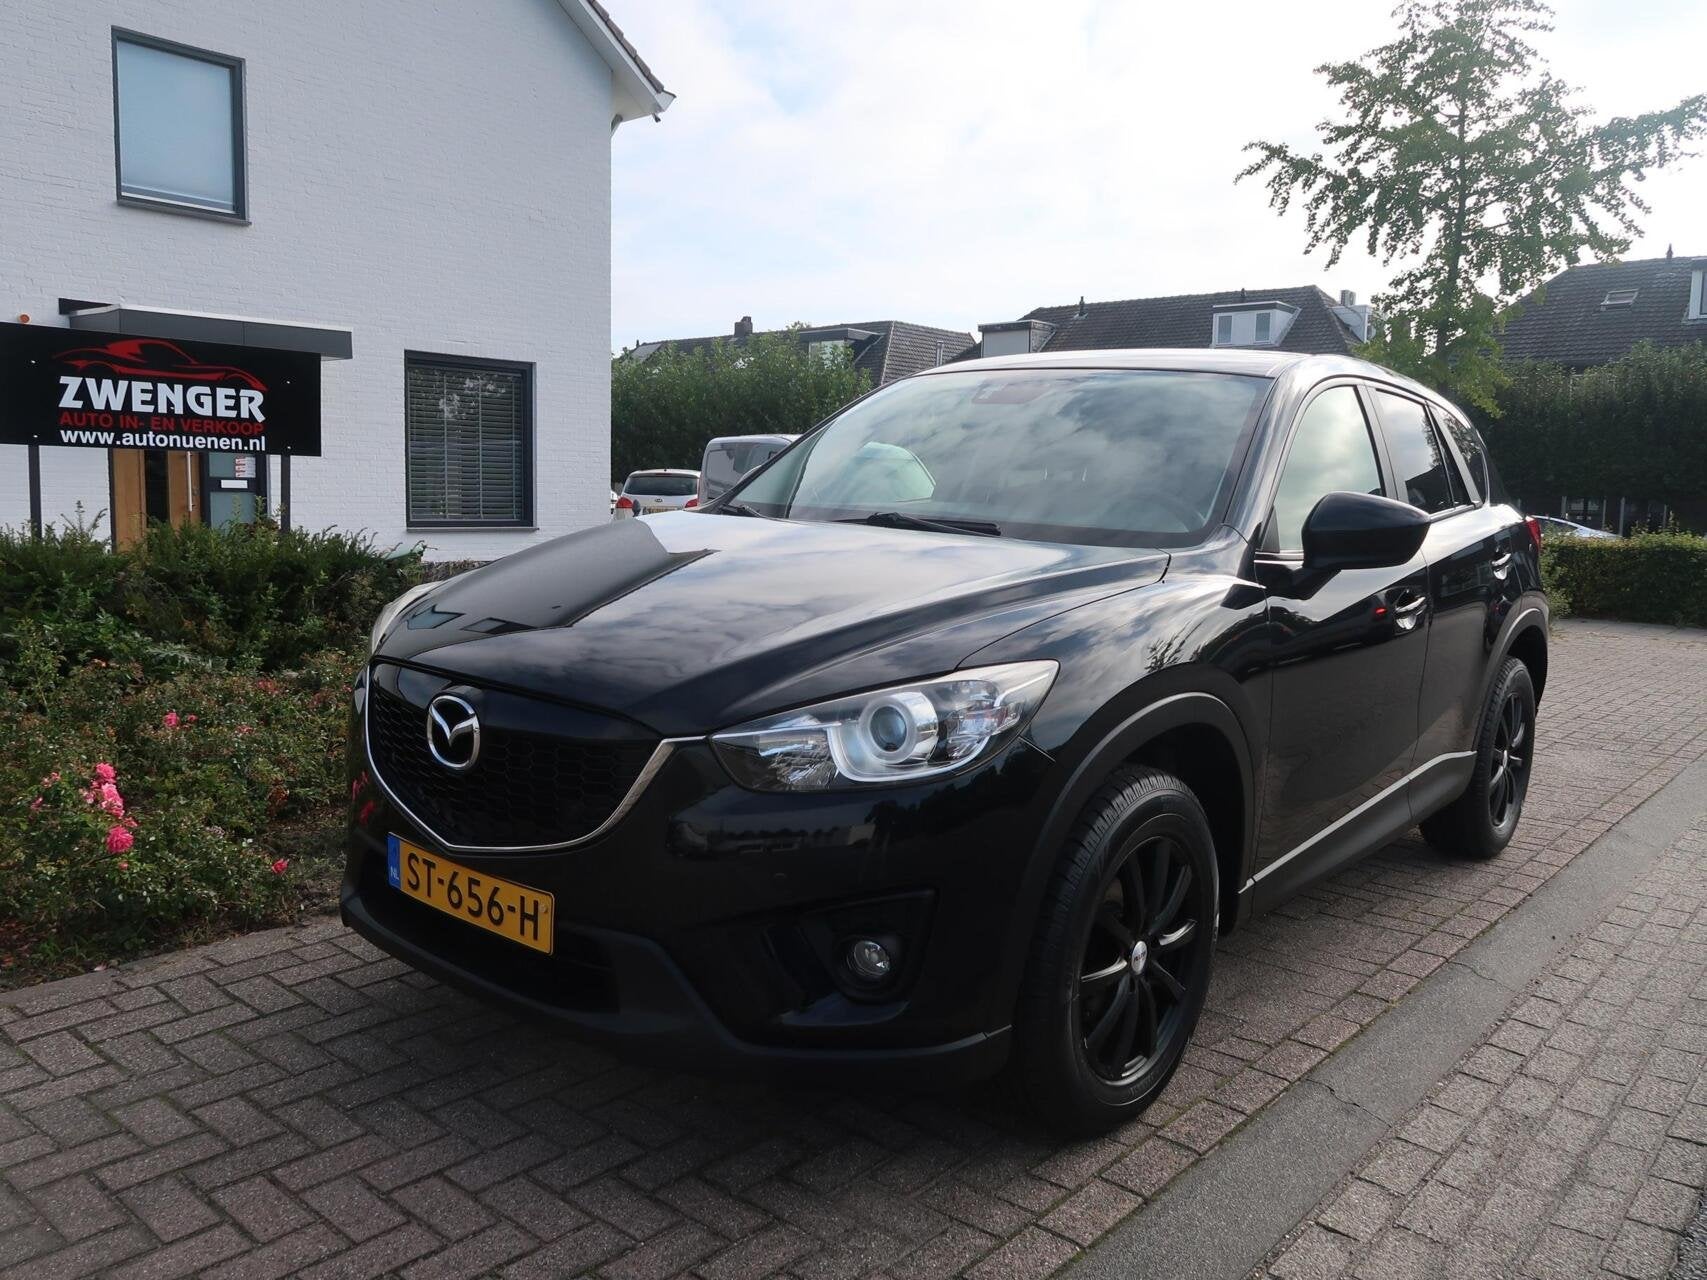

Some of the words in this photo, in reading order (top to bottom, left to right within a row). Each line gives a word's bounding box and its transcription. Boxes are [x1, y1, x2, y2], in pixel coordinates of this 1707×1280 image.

[58, 375, 266, 423] ZWENGER
[60, 410, 114, 429] AUTO
[119, 414, 145, 430] IN-
[151, 416, 176, 432] EN
[181, 418, 264, 436] VERKOOP
[60, 429, 266, 452] www.autonuenen.nl
[389, 865, 400, 881] NL
[407, 852, 540, 942] ST-656-H
